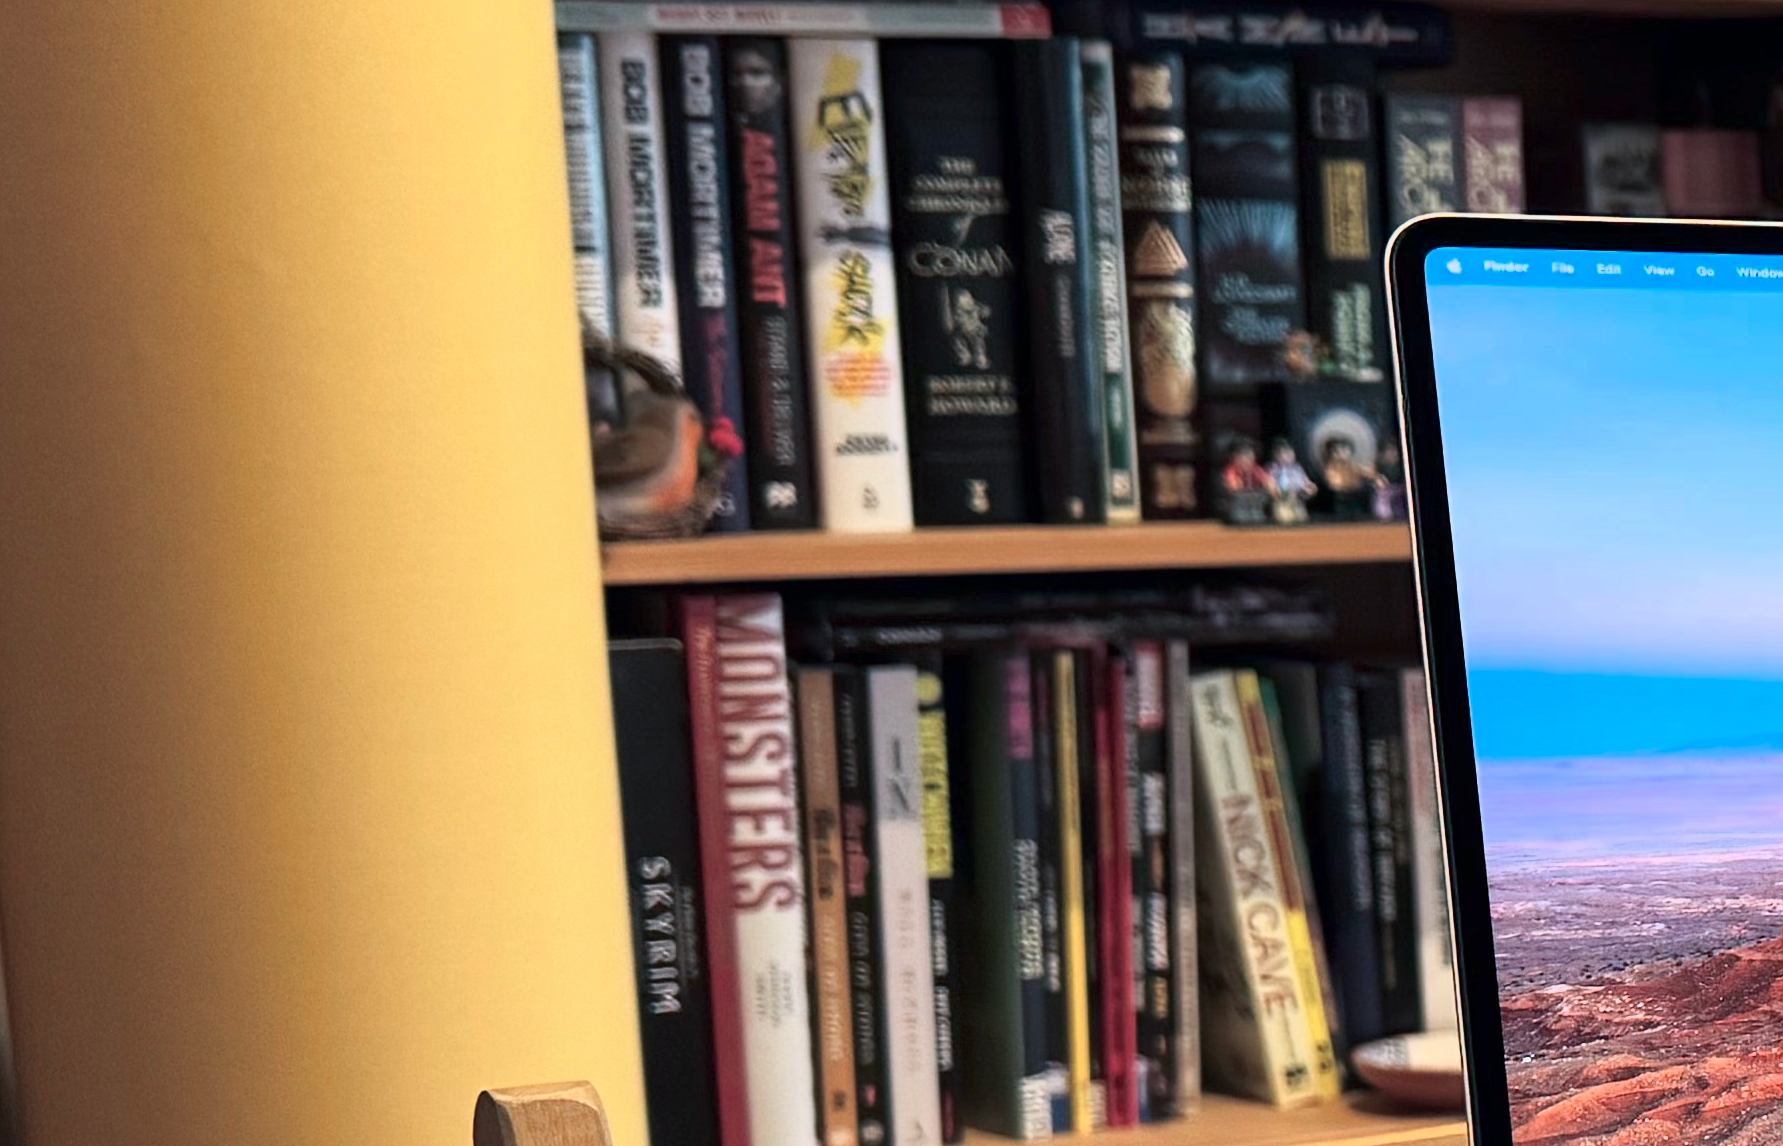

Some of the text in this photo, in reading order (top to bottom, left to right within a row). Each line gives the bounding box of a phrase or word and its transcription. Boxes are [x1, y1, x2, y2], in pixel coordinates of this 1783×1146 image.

[681, 43, 713, 118] BOB
[621, 60, 663, 309] BOB MORTIMER
[688, 121, 726, 308] MORTIMER
[742, 127, 787, 309] ADAM ANT
[909, 241, 1015, 277] CONAN
[1483, 260, 1529, 273] Finder
[1551, 262, 1575, 274] File
[1597, 263, 1621, 275] Edit
[1644, 265, 1675, 276] View
[1696, 266, 1715, 277] Go
[716, 595, 796, 912] MONSTERS
[636, 856, 682, 1015] SKYRIM
[1221, 795, 1298, 1017] NICK CAVE
